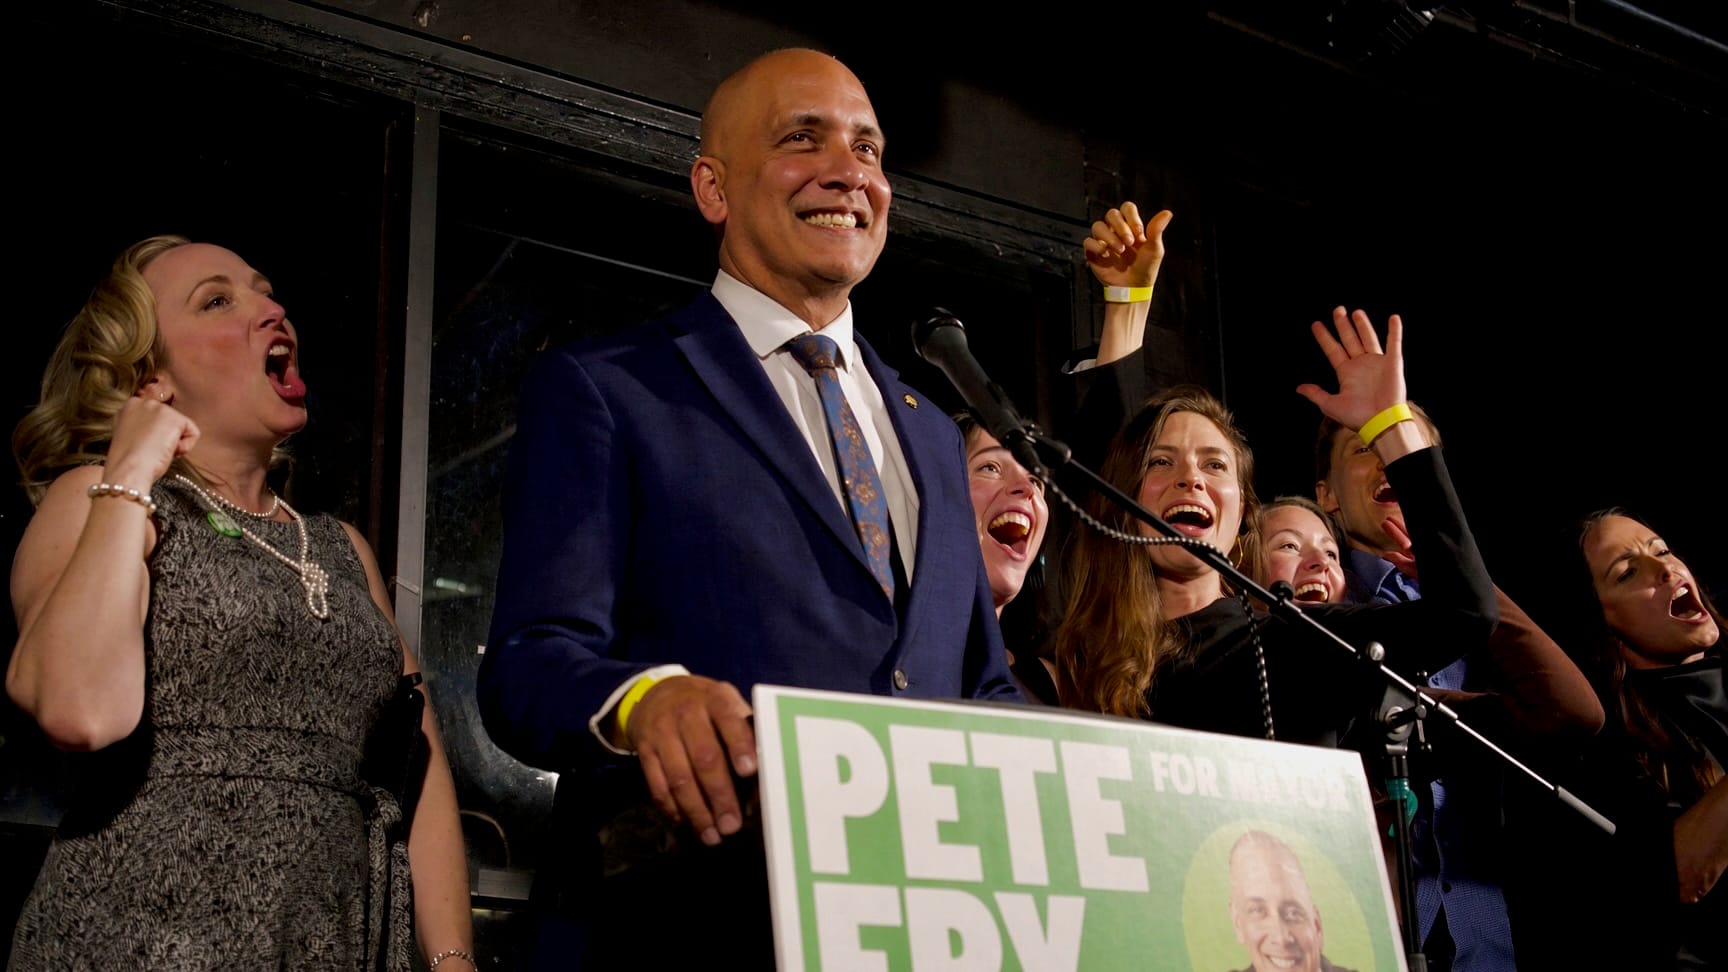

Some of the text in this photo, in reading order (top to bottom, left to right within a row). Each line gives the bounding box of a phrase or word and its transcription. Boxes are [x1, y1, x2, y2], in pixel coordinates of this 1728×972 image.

[795, 716, 1149, 892] PETE
[1150, 752, 1353, 812] FOR MAYOR
